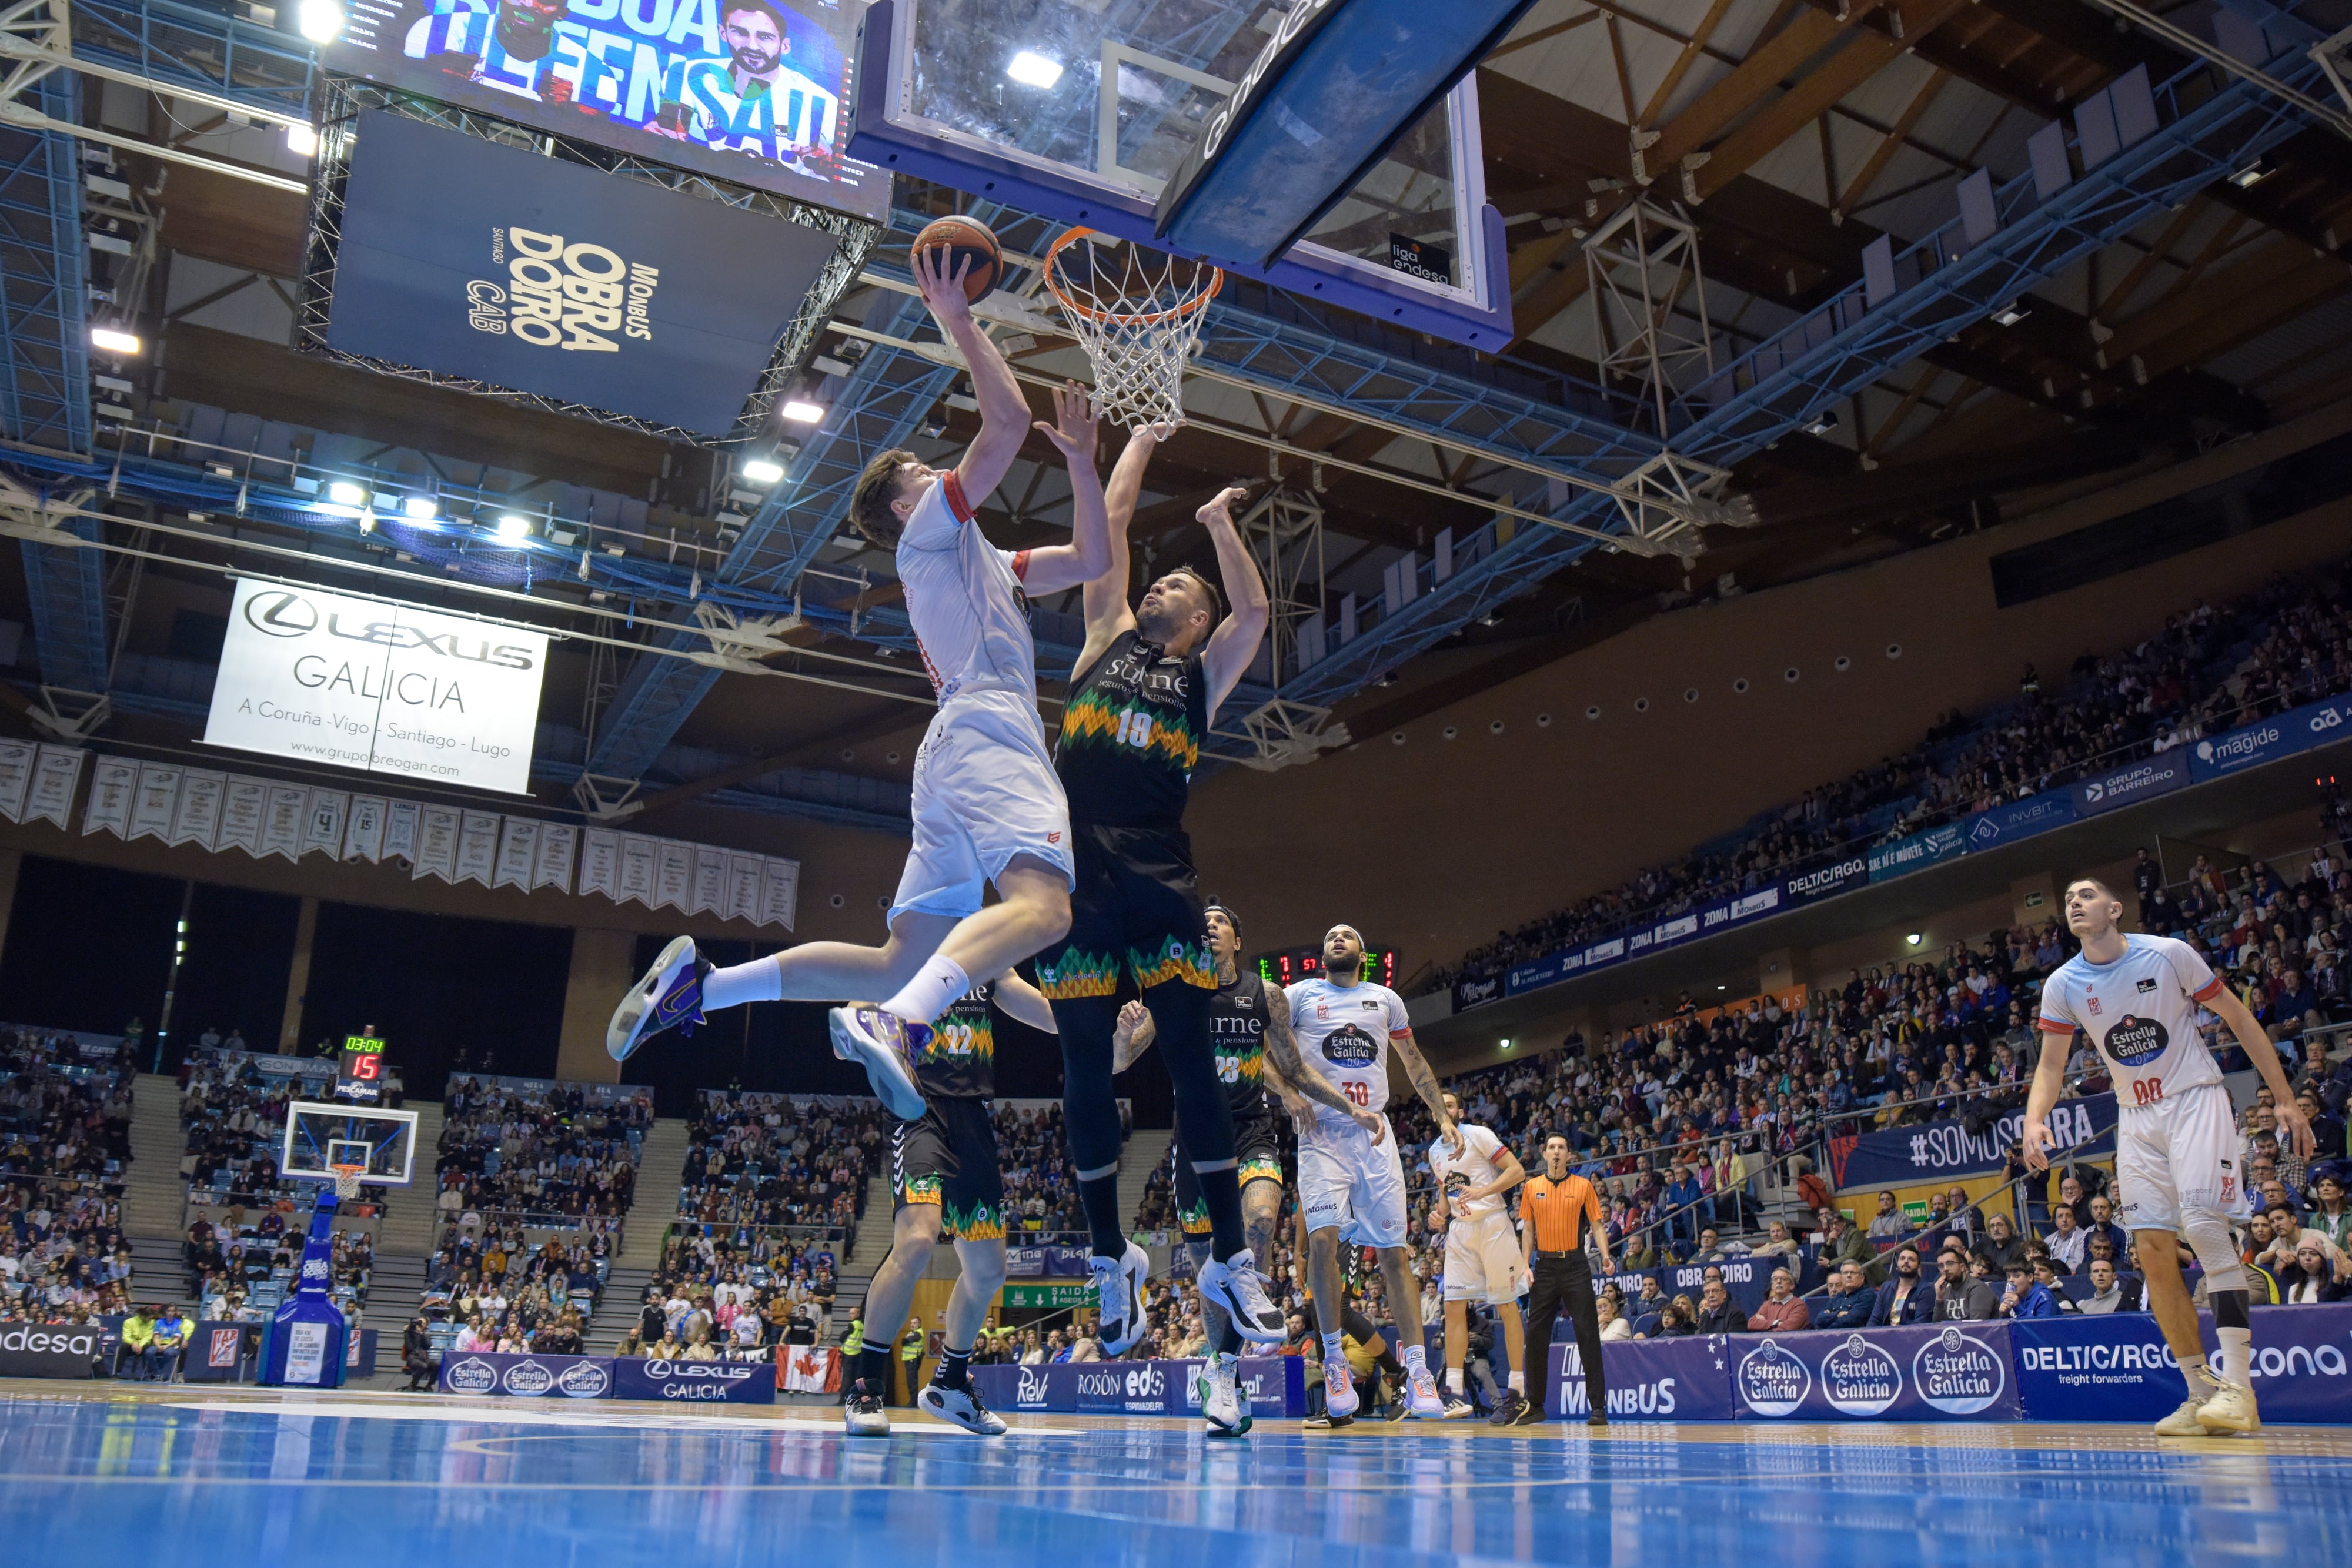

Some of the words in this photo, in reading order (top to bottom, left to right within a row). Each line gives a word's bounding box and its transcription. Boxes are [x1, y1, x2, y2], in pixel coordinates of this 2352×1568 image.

[493, 227, 503, 264] SANTIAGO
[1393, 243, 1418, 263] liga
[509, 227, 564, 346] DOIRO
[467, 280, 506, 335] CAB
[562, 243, 626, 352] OBRA
[625, 262, 659, 340] MONBUS
[328, 613, 533, 670] LEXUS
[293, 655, 465, 713] GALICIA
[1098, 678, 1131, 695] seguros
[238, 698, 252, 714] A
[259, 701, 321, 727] Coruña
[388, 723, 456, 750] Santiago
[471, 737, 510, 759] Lugo
[1116, 708, 1152, 748] 19
[2217, 727, 2280, 758] magide
[291, 741, 459, 777] www.grupobreogan.com
[2106, 767, 2153, 787] GRUPO
[2108, 769, 2174, 796] BARREIRO
[360, 819, 372, 830] 15
[1704, 907, 1729, 928] ZONA
[1736, 900, 1766, 917] MONBUS
[1630, 931, 1653, 950] ZONA
[1660, 925, 1686, 940] MONBUS
[1302, 958, 1317, 971] 57
[1563, 952, 1583, 972] ZONA
[956, 1005, 986, 1013] pensiones
[346, 1037, 383, 1053] 03:04
[946, 1025, 972, 1054] 22
[1223, 1037, 1258, 1045] pensiones
[1331, 1035, 1371, 1047] Estrella
[2112, 1025, 2157, 1045] Estrella
[1333, 1047, 1369, 1058] Galicia
[2117, 1039, 2158, 1057] Galicia
[353, 1054, 380, 1079] 15
[1215, 1056, 1240, 1083] 23
[337, 1085, 378, 1096] PESCAMAR
[1342, 1081, 1369, 1107] 30
[1308, 1203, 1337, 1214] MONBUS
[1905, 1206, 1927, 1219] SAIDA
[303, 1261, 328, 1271] OBRA
[1051, 1286, 1090, 1295] SAIDA
[674, 1365, 751, 1379] LEXUS
[1747, 1361, 1802, 1379] Estrella
[1831, 1358, 1890, 1378] Estrella
[1925, 1352, 1992, 1373] Estrella
[455, 1367, 491, 1379] Estrella
[455, 1377, 489, 1389] Galicia
[510, 1370, 547, 1381] Estrella
[567, 1370, 602, 1381] Estrella
[1078, 1369, 1120, 1396] ROSÓN
[2059, 1373, 2090, 1386] freight
[2092, 1373, 2143, 1385] forwarders
[512, 1379, 544, 1390] Galicia
[567, 1380, 599, 1391] Galicia
[663, 1383, 727, 1400] GALICIA
[1751, 1379, 1798, 1399] Galicia
[1836, 1378, 1890, 1399] Galicia
[1929, 1372, 1991, 1395] Galicia
